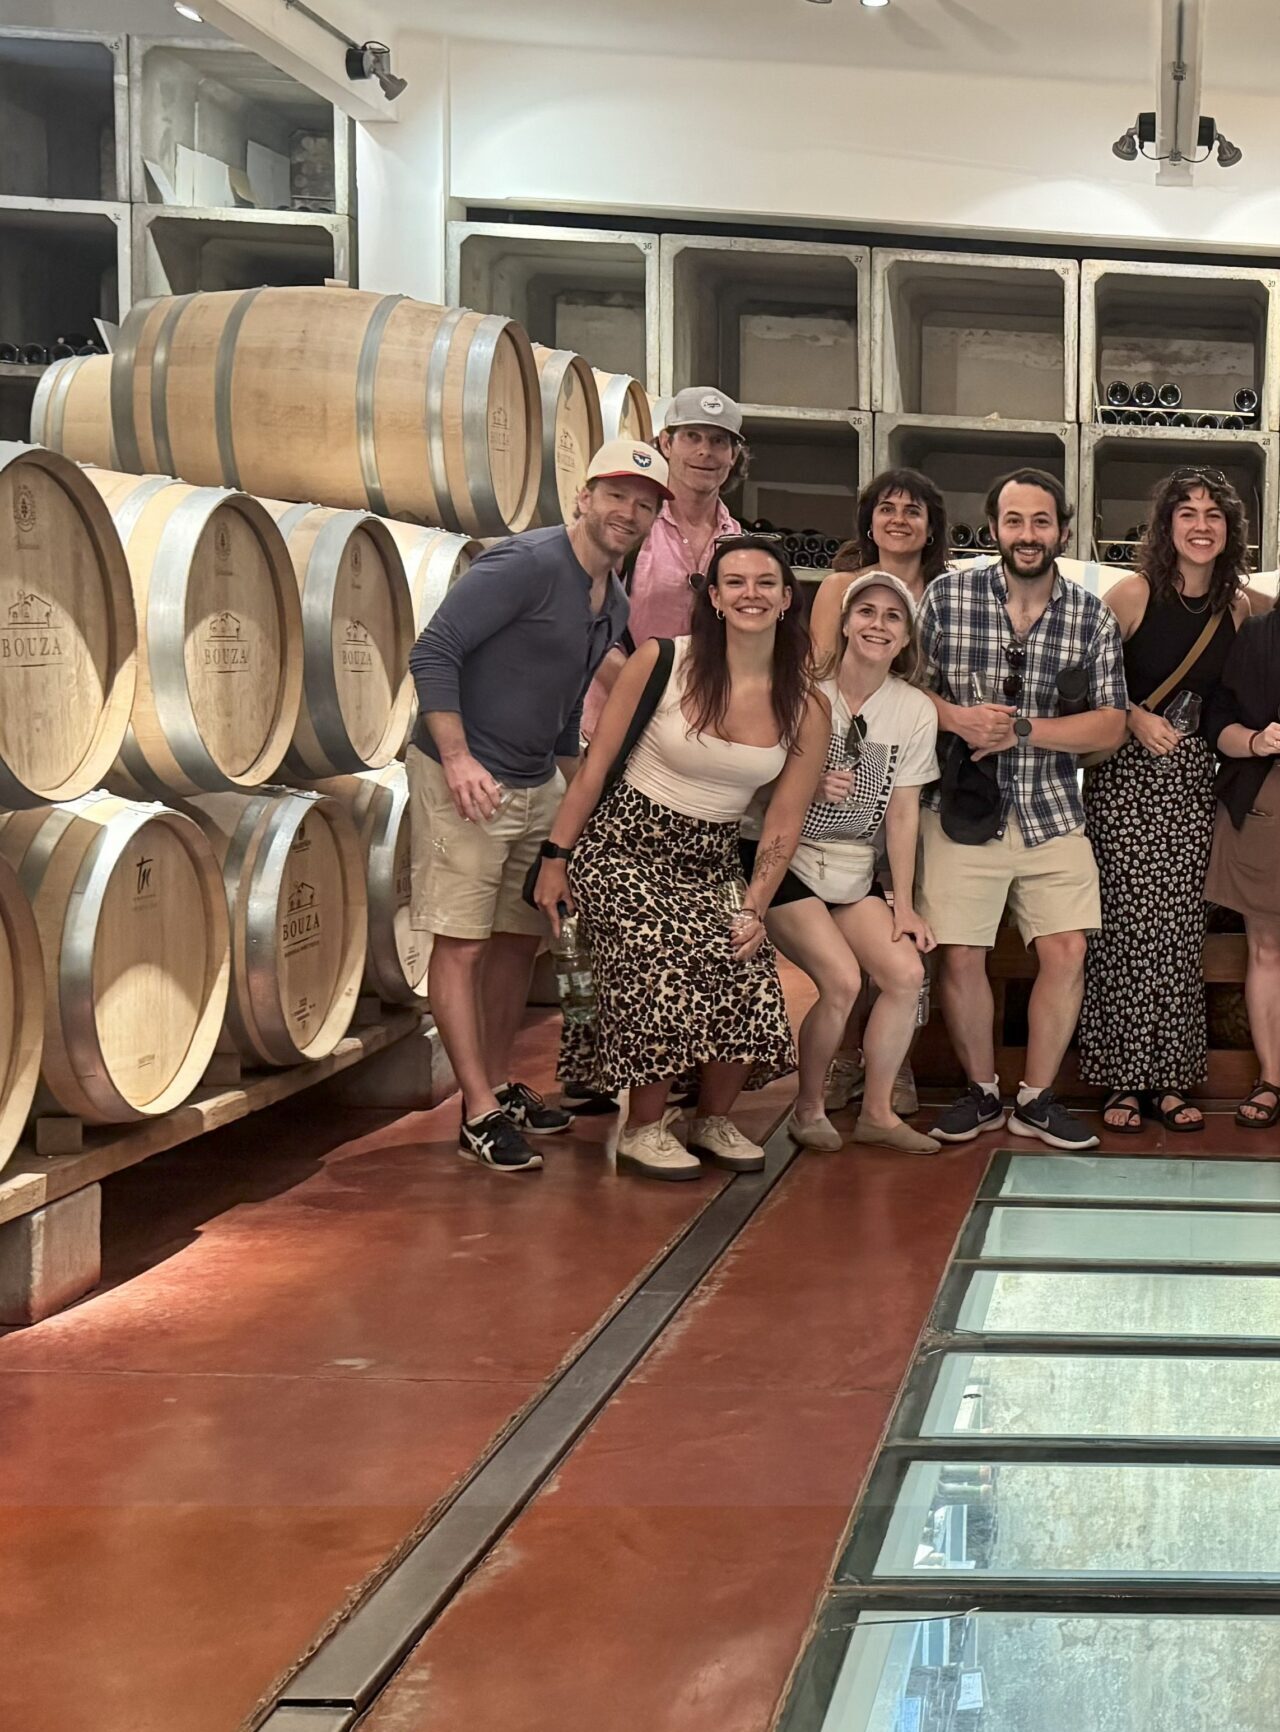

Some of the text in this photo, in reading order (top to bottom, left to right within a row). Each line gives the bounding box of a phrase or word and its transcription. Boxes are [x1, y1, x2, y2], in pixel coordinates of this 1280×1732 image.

[2, 637, 62, 658] BOUZA
[204, 647, 248, 665] BOUZA
[342, 650, 373, 666] BOUZA
[880, 744, 899, 797] BEACH
[282, 911, 320, 941] BOUZA
